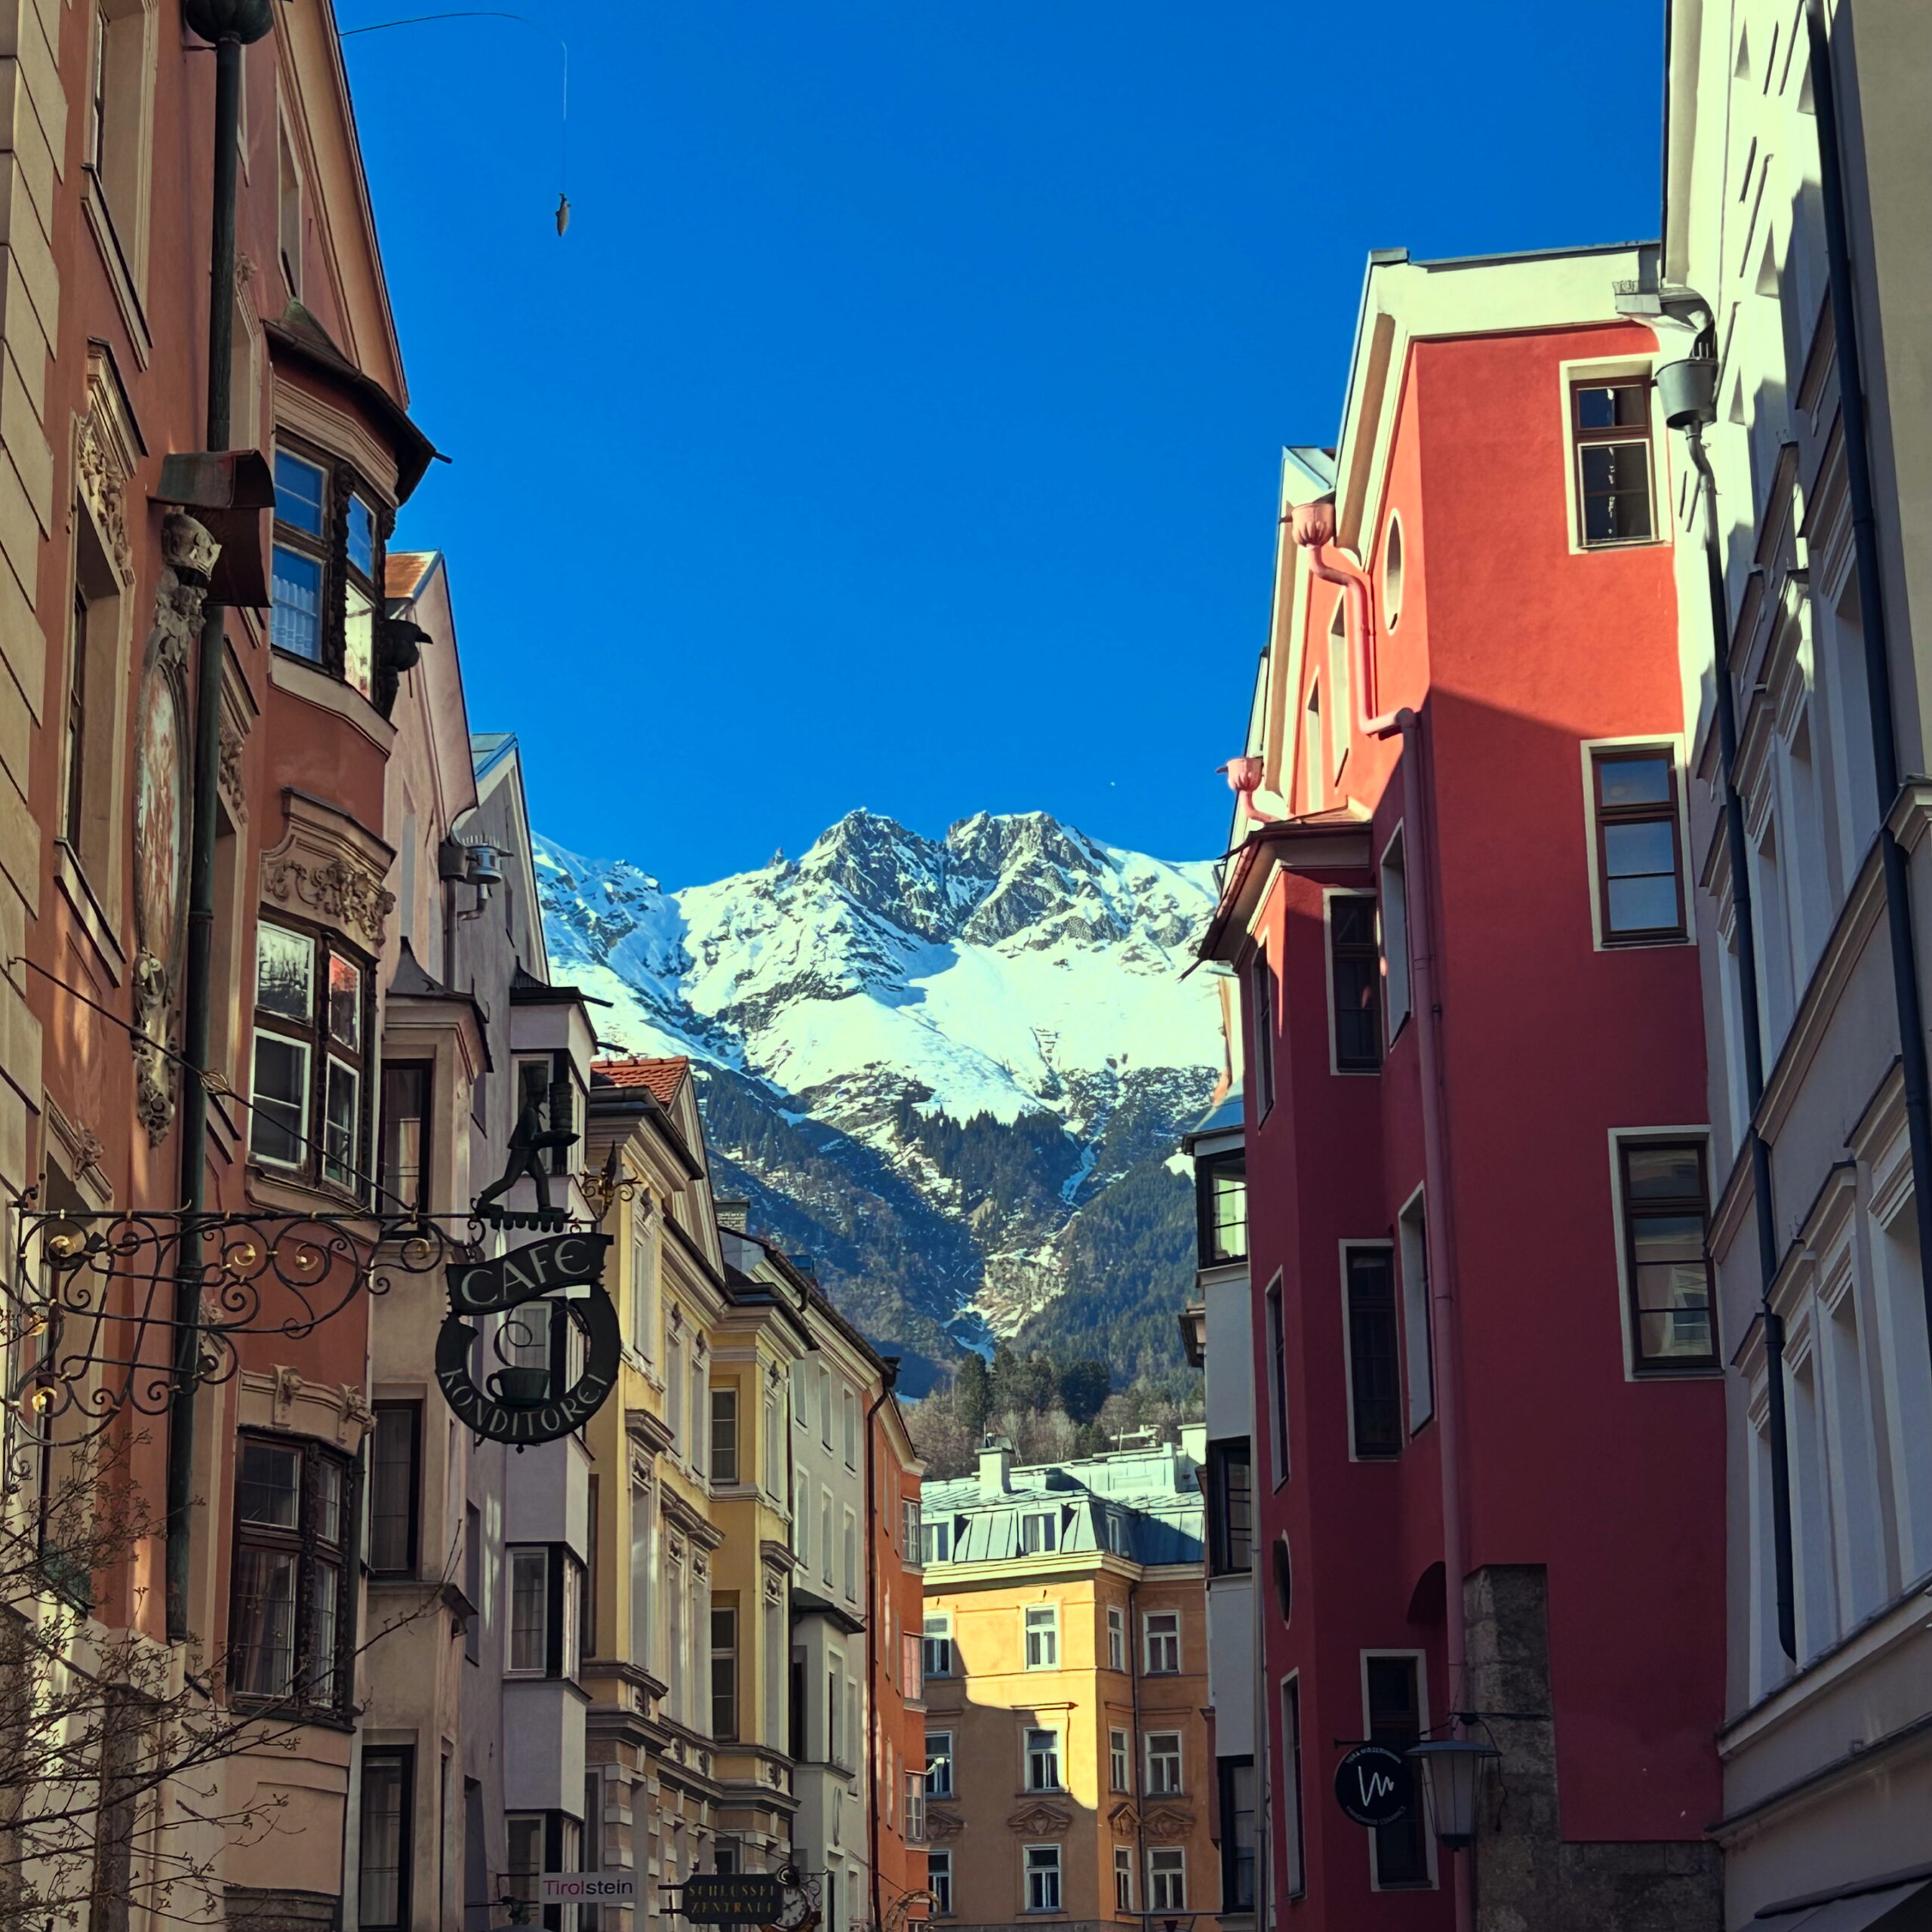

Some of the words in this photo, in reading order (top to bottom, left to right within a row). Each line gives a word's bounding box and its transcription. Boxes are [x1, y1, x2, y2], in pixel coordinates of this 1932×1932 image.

[461, 1238, 590, 1305] CAFE
[441, 1367, 608, 1436] KONDITOREI
[543, 1878, 632, 1896] Tirolstein
